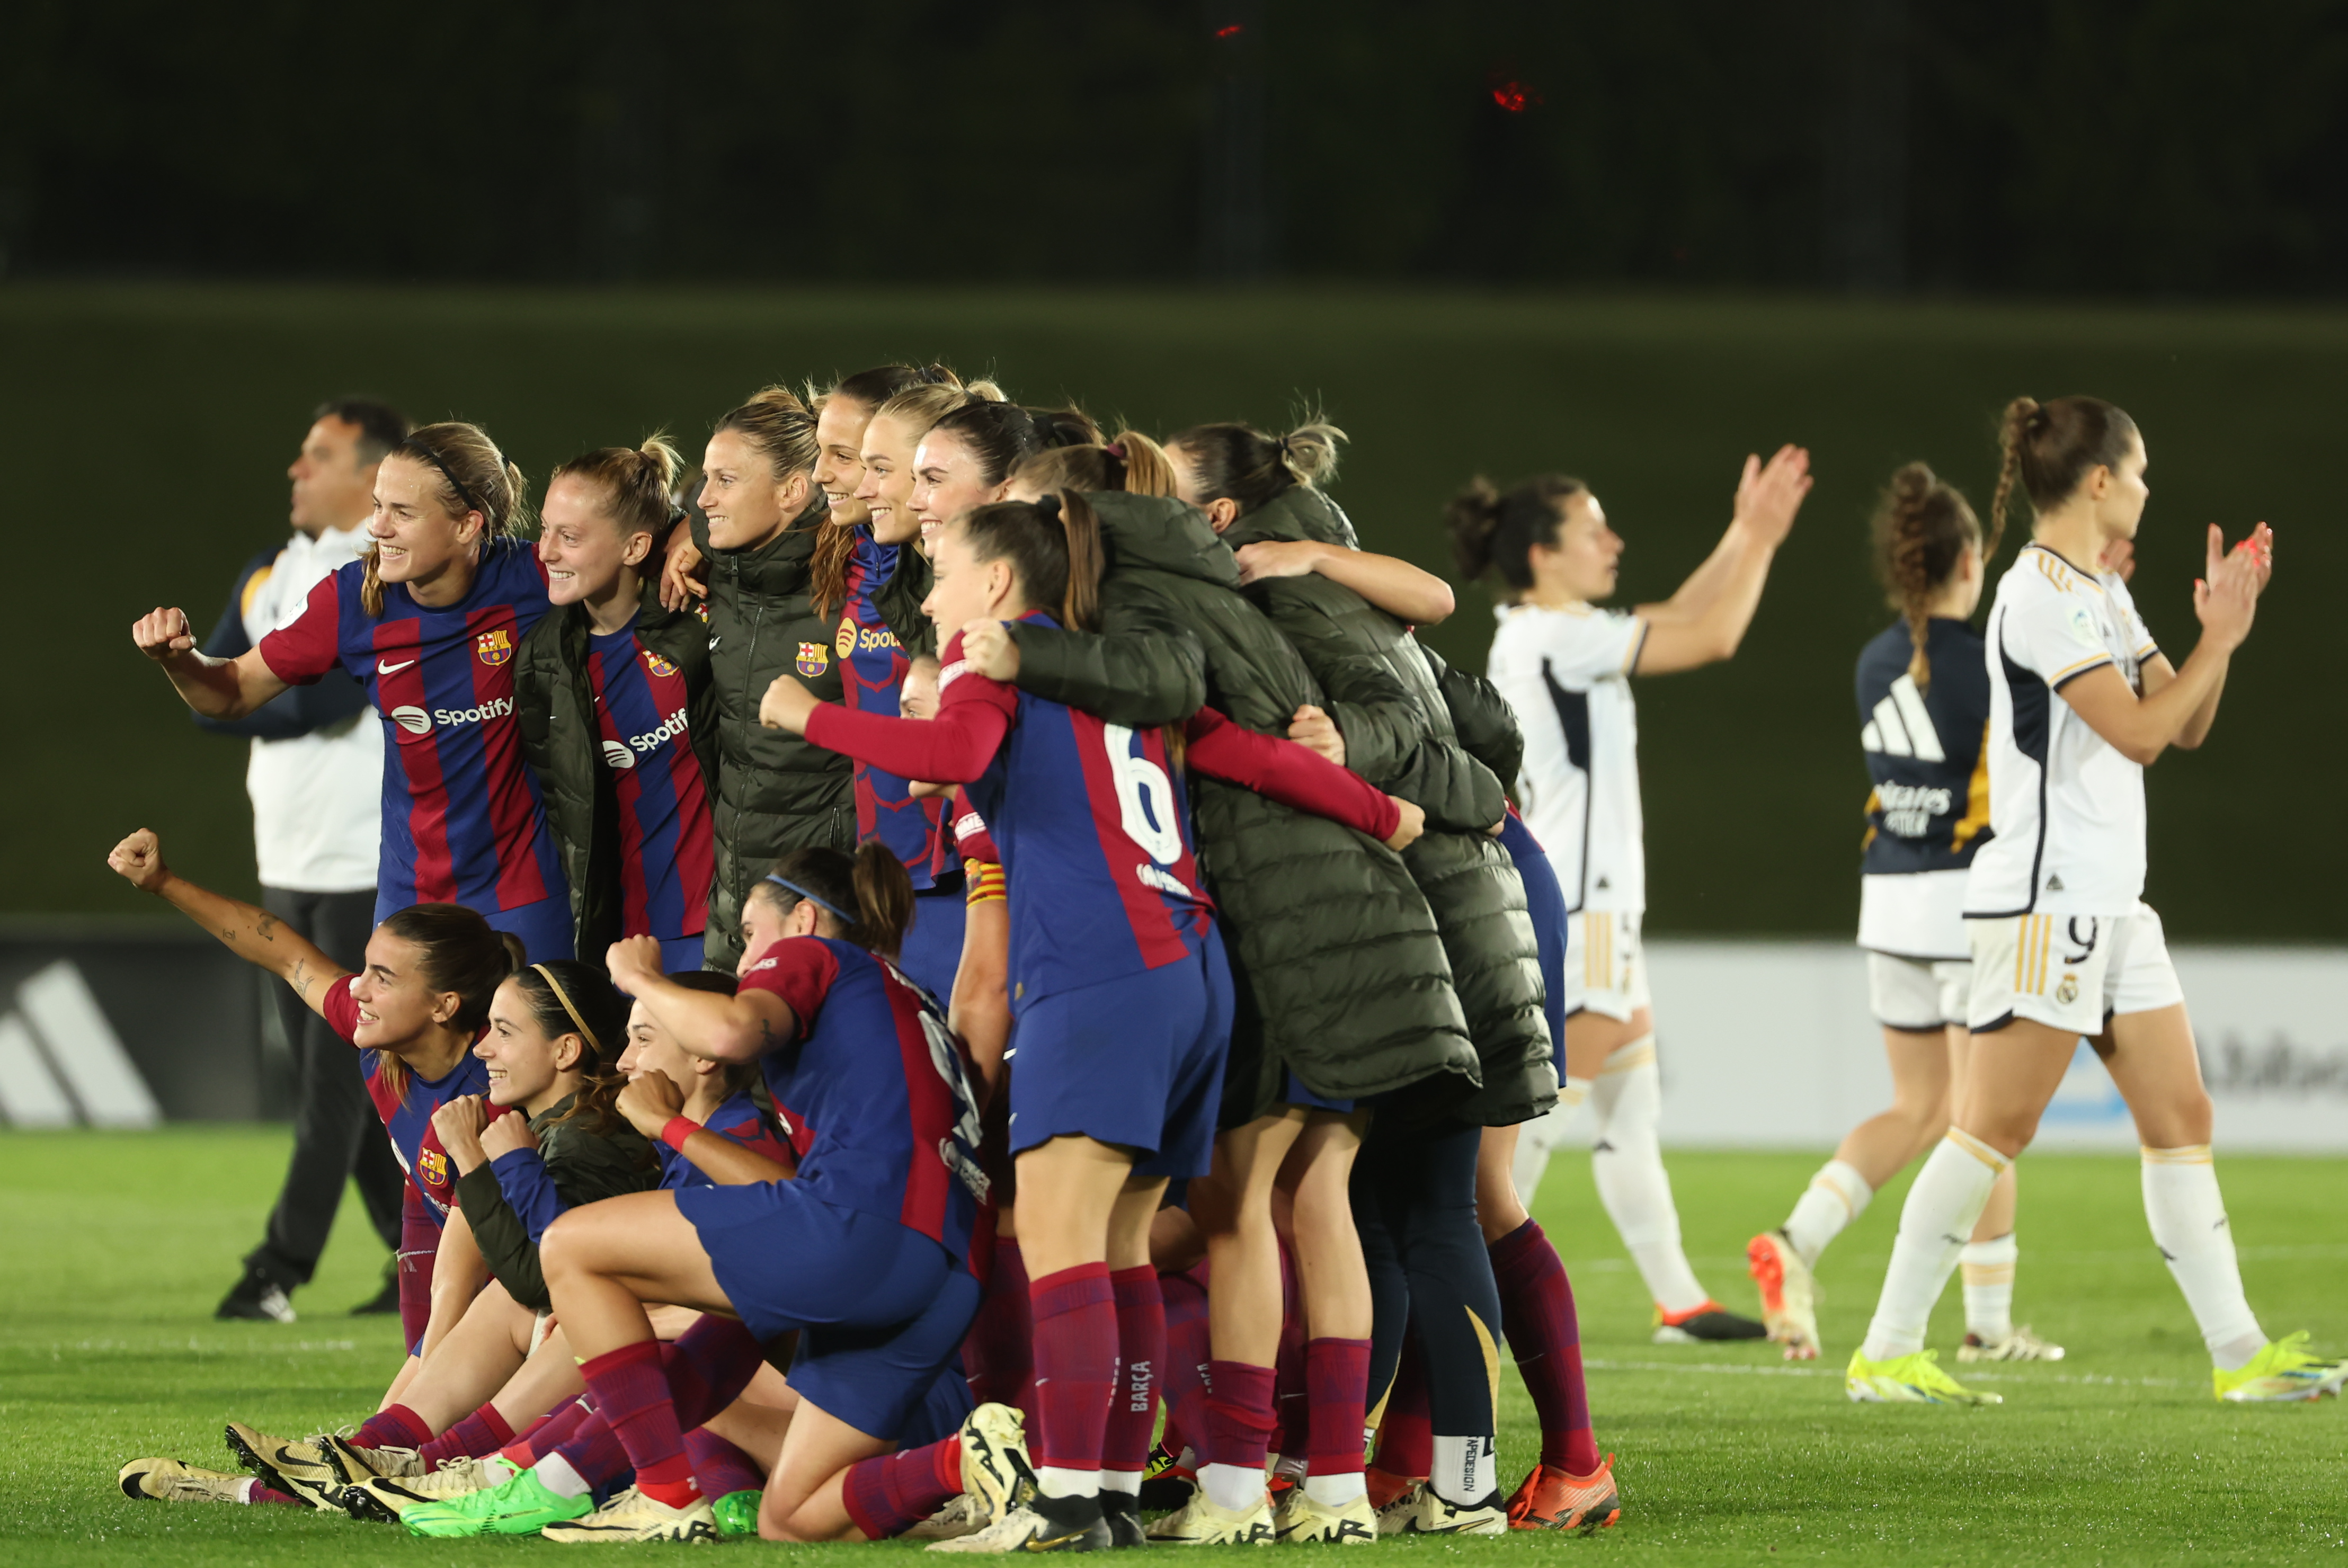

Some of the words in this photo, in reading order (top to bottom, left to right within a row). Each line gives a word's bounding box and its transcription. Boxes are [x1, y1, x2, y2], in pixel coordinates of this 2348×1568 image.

[858, 628, 901, 652] Spot
[434, 696, 514, 726] Spotify
[629, 707, 689, 752] Spotif
[1103, 723, 1183, 865] 6
[2064, 914, 2098, 965] 9
[1130, 1360, 1154, 1412] BARÇA
